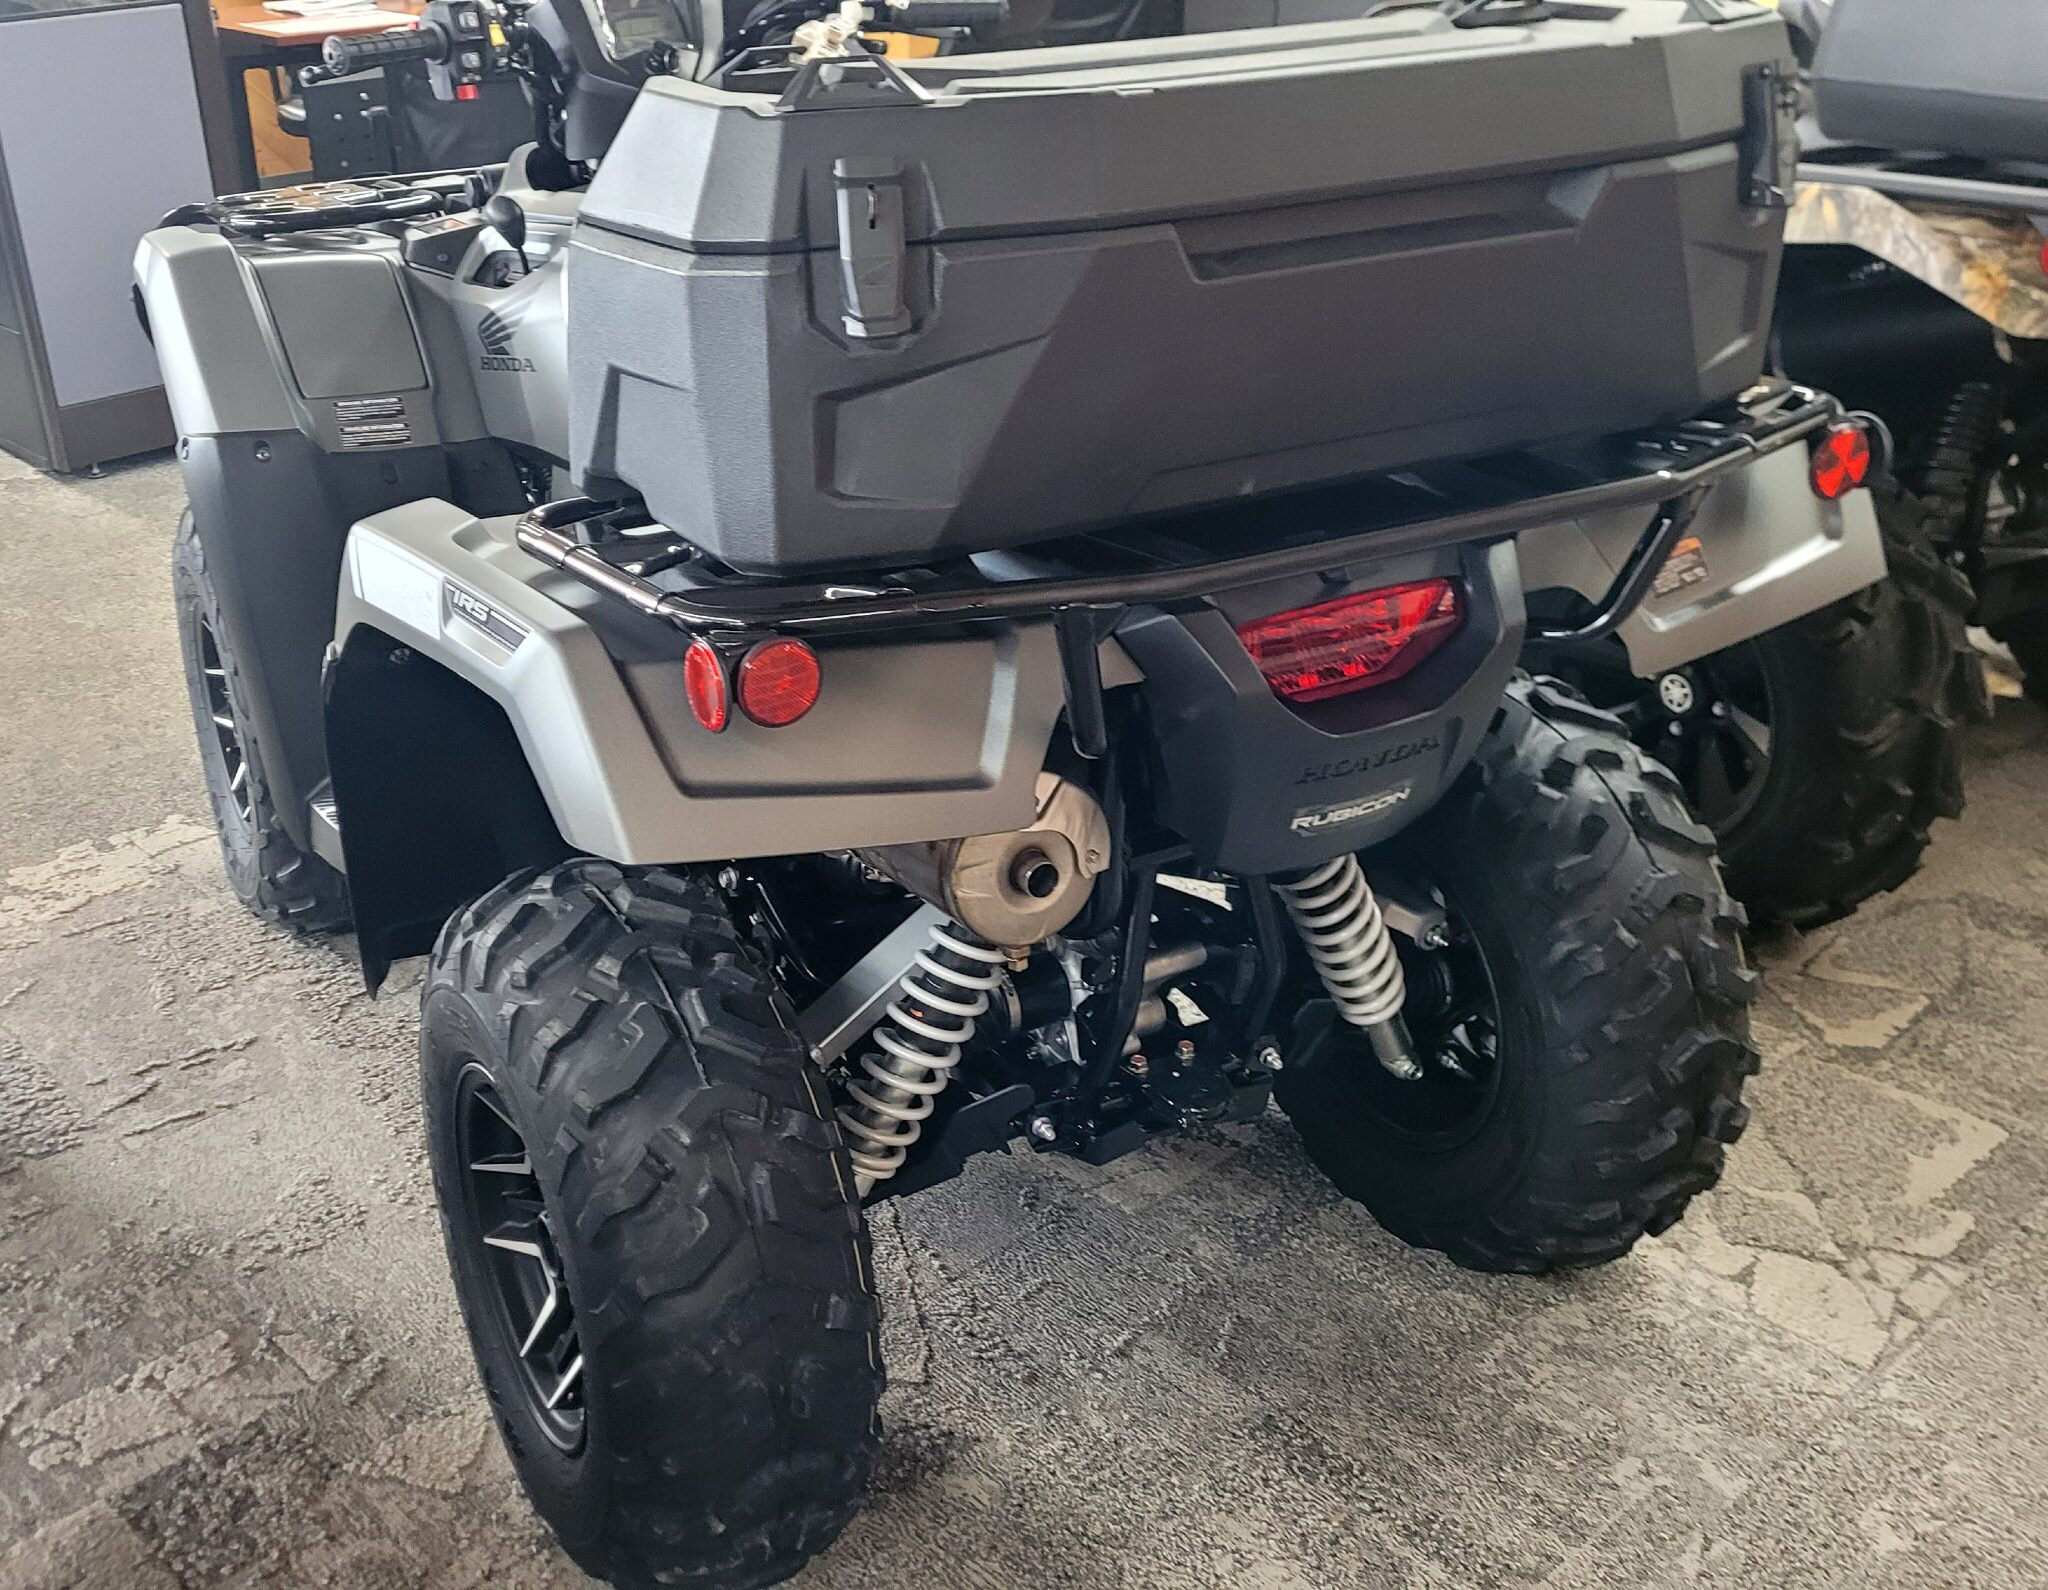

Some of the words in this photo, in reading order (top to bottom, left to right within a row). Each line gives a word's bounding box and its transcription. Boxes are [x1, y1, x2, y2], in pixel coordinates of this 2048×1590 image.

[480, 356, 538, 372] HONDA
[453, 589, 490, 622] IRS
[1293, 736, 1441, 785] HONDA
[1290, 787, 1412, 830] RUBICON
